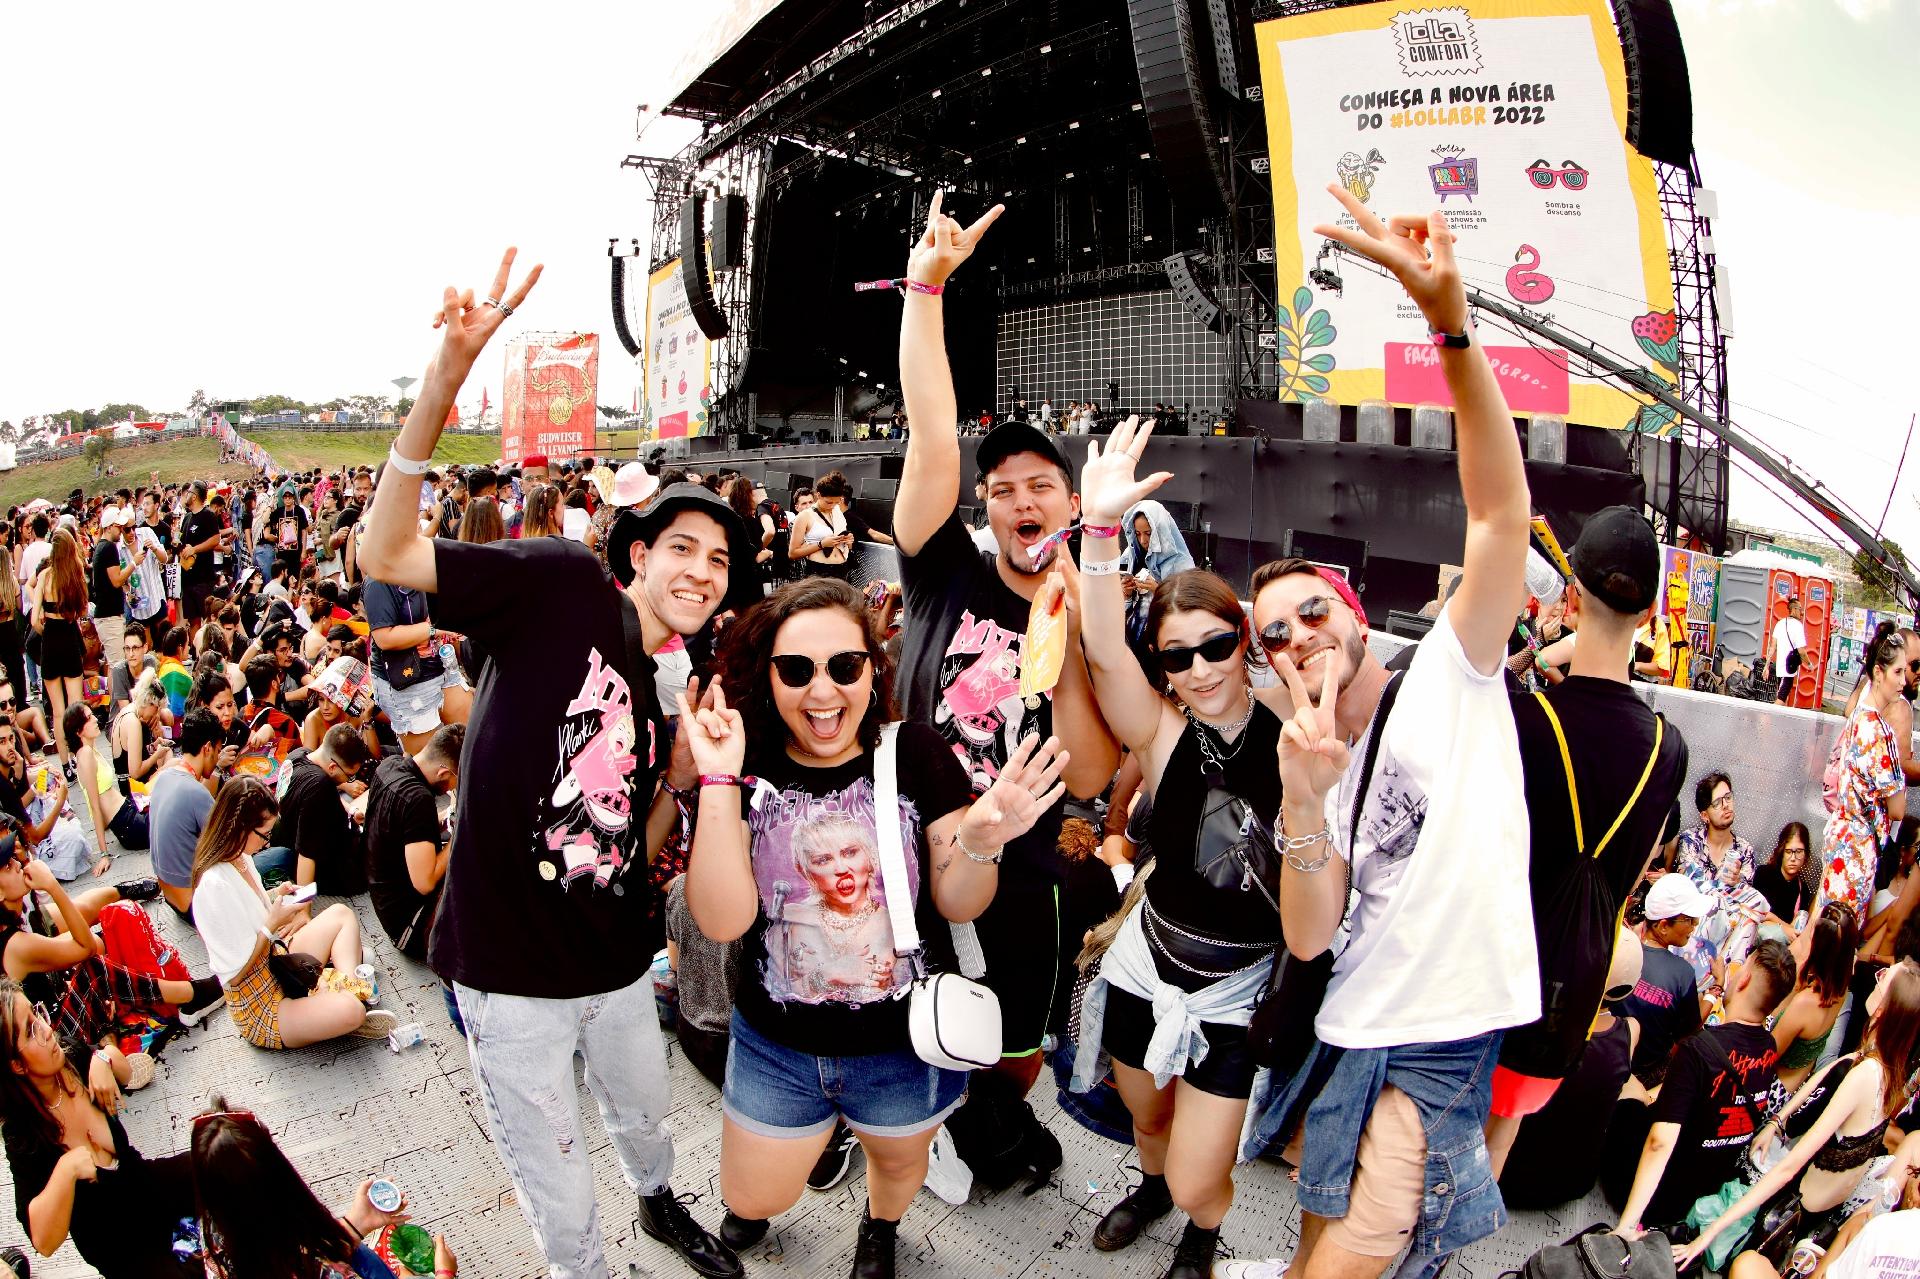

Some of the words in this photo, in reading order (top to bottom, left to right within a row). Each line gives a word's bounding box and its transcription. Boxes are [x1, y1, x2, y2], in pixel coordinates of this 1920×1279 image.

[1409, 43, 1469, 62] COMFORT
[1340, 88, 1424, 113] CONHEÇA
[1430, 87, 1442, 105] A
[1448, 84, 1501, 104] NOVA
[1507, 81, 1556, 103] ÁREA
[1357, 113, 1383, 131] DO
[1390, 106, 1487, 129] #LOLLABR
[1492, 105, 1546, 125] 2022
[1545, 201, 1574, 209] Sombra
[1404, 344, 1441, 368] FAÇA
[538, 431, 583, 443] BUDWEISER
[1701, 1137, 1729, 1148] SOUTH
[1868, 1255, 1920, 1272] ATTENTION
